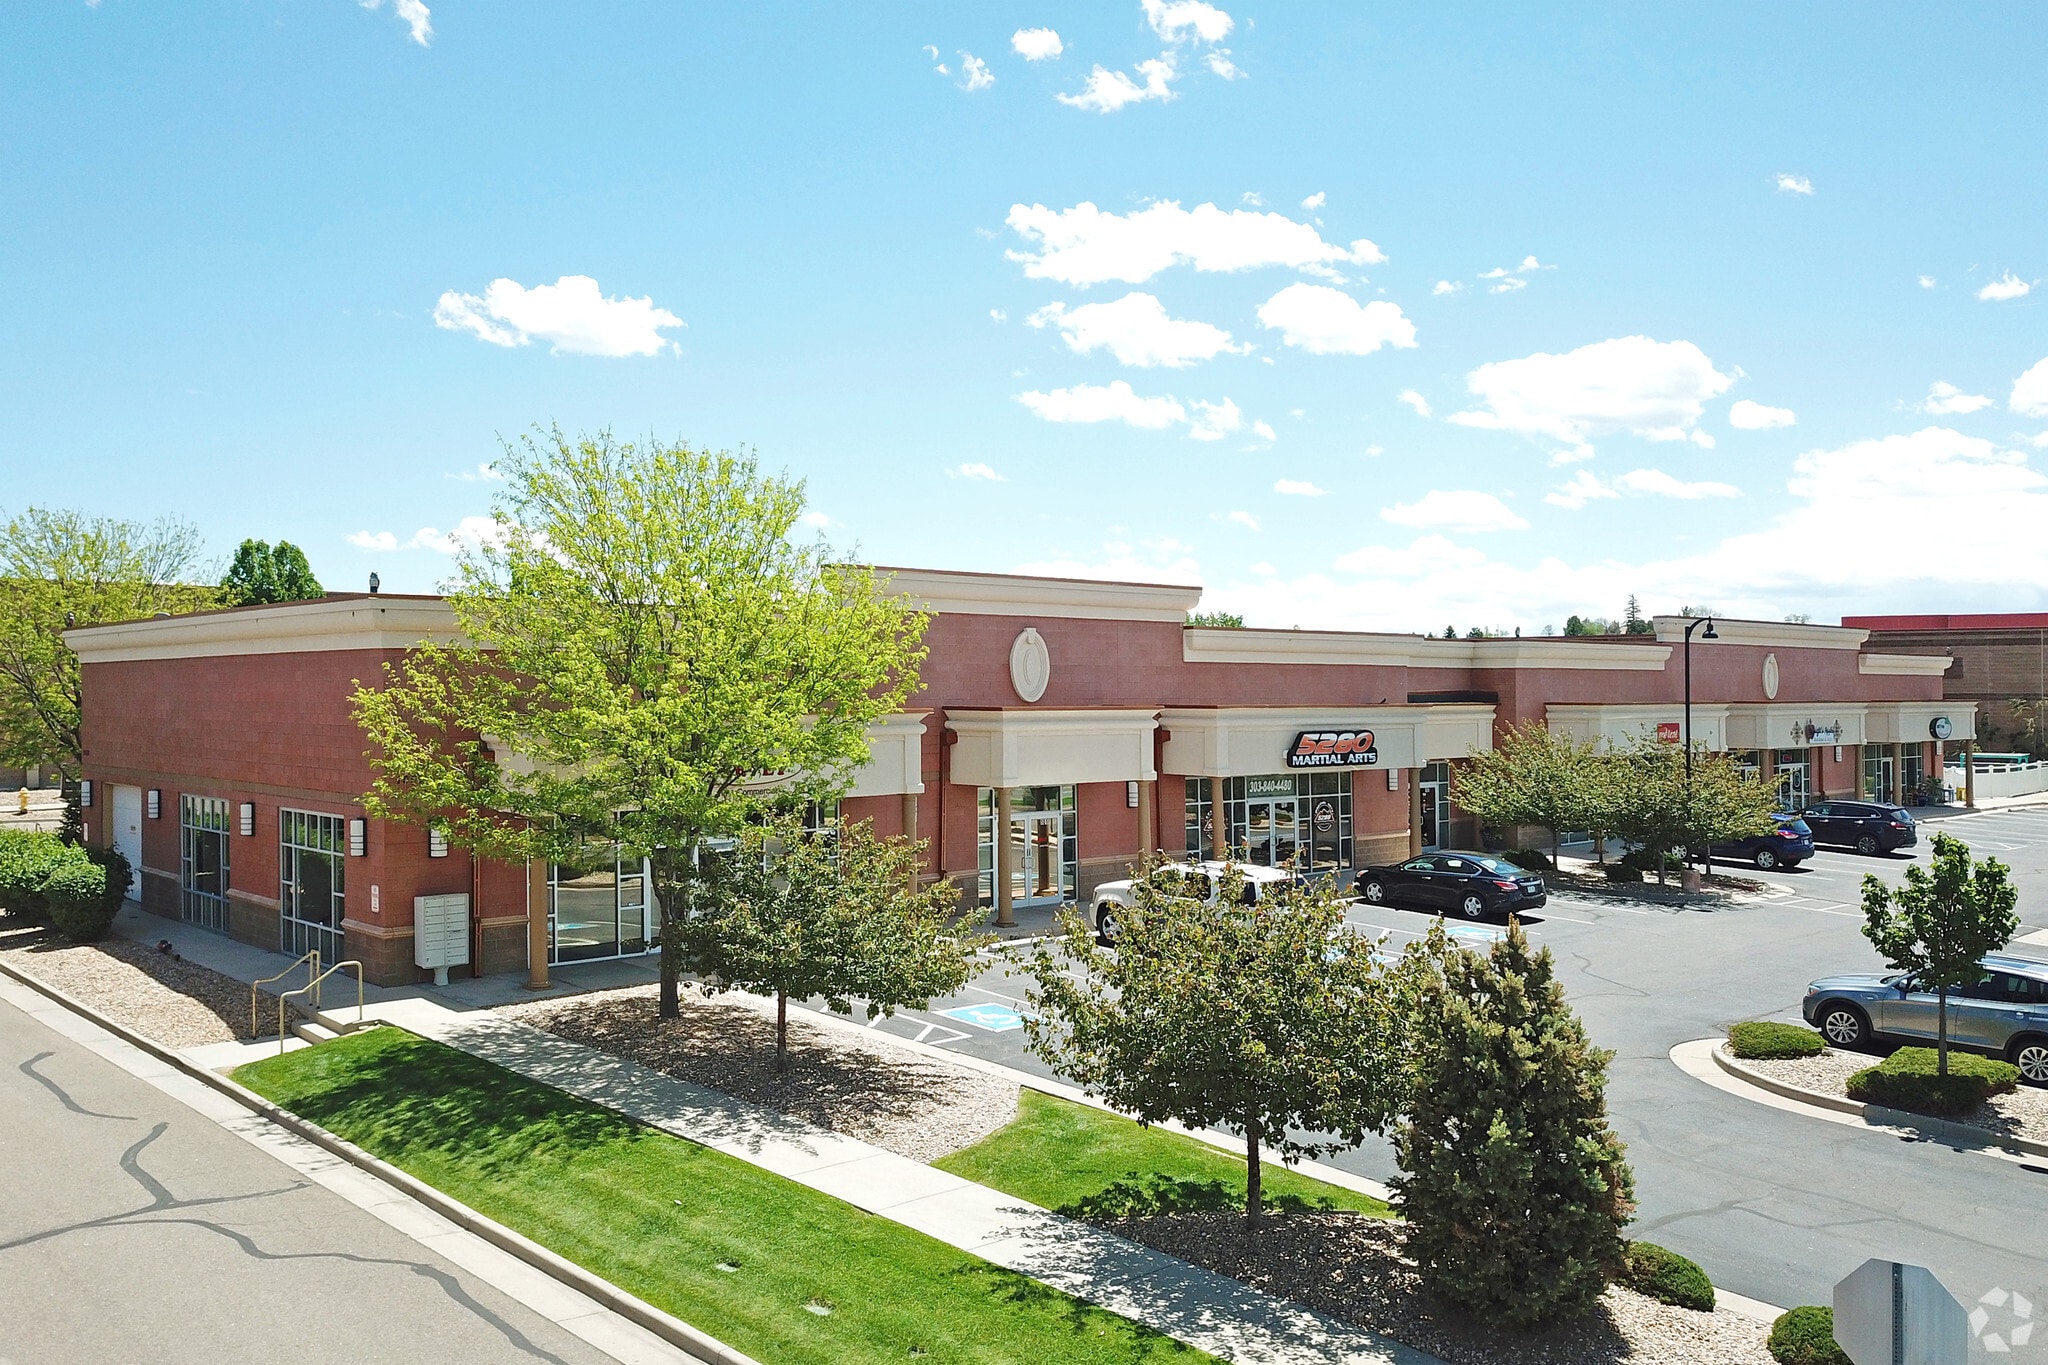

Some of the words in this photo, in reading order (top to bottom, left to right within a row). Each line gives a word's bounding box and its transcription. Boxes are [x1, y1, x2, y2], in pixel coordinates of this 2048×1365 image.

[1296, 732, 1374, 755] 5280
[1293, 755, 1344, 766] MARTIAL
[1347, 752, 1377, 763] ARTS
[1249, 779, 1292, 793] 303-840-4480
